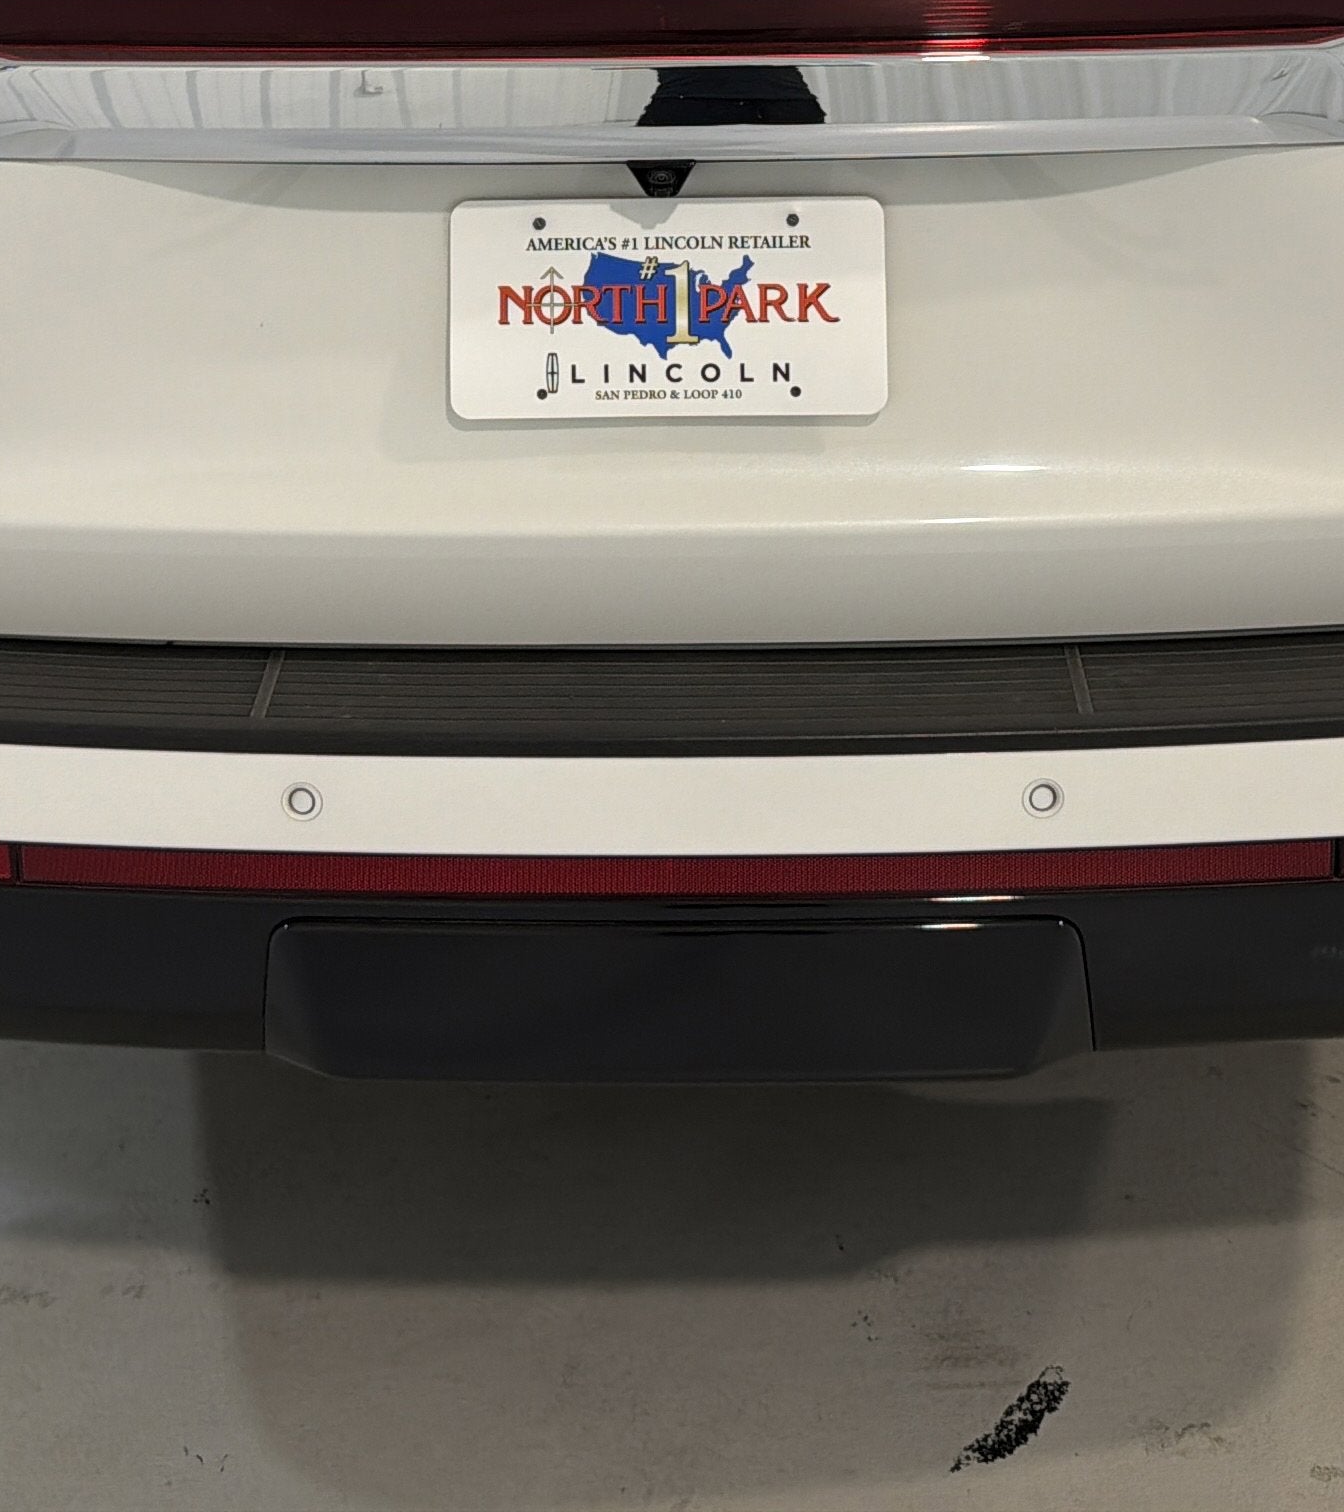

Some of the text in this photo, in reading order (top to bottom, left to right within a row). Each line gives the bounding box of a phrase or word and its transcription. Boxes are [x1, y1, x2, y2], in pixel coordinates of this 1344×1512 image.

[526, 235, 812, 251] AMERICA'S #1 LINCOLN RETAILER
[497, 282, 841, 326] NORTH PARK
[571, 362, 791, 384] LINCOLN
[595, 389, 743, 400] SAN PEDRO & LOOP 410
